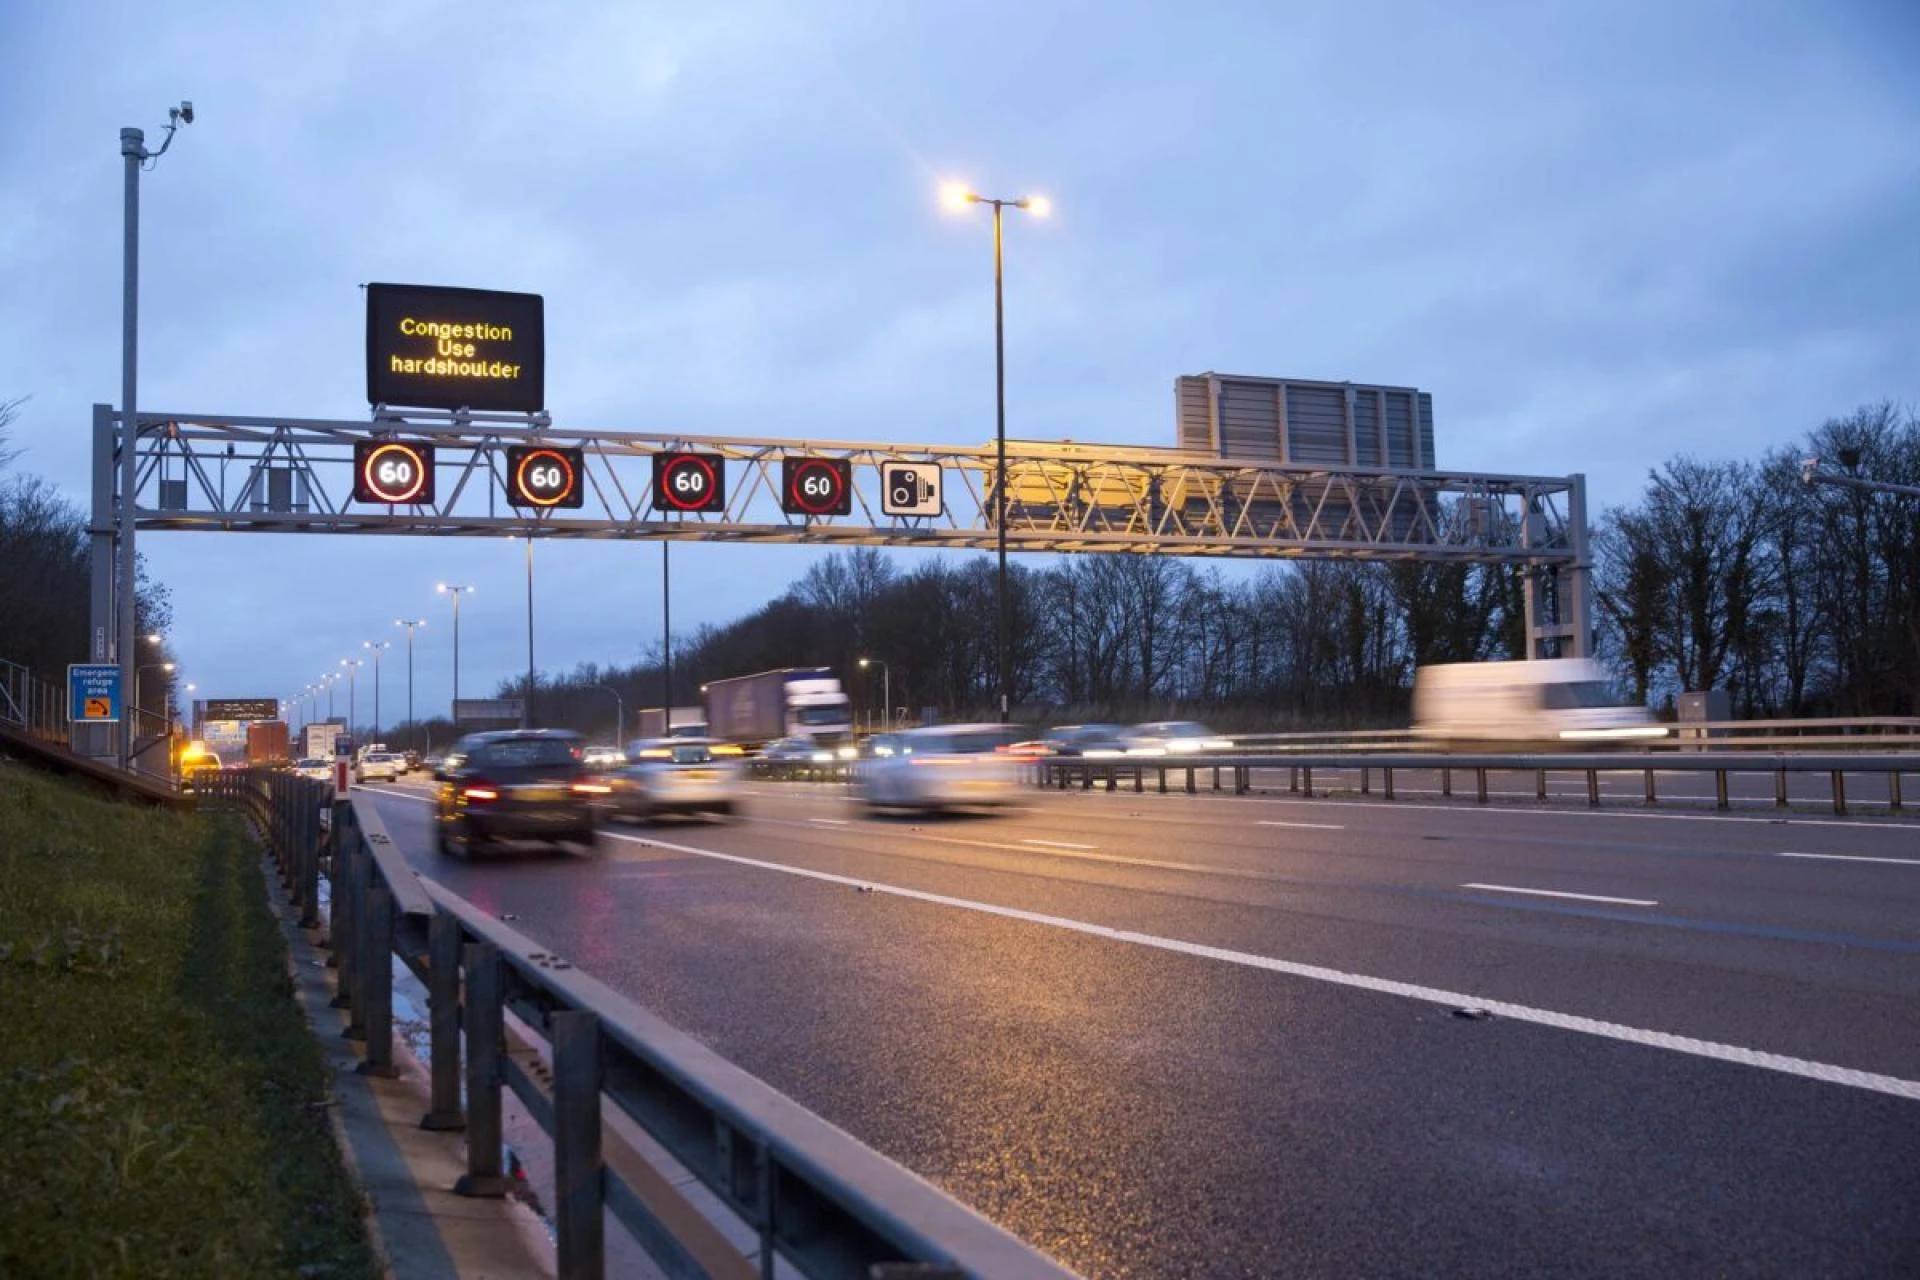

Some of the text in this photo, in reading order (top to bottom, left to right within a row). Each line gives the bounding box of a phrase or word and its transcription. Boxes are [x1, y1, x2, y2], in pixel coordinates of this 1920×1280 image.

[400, 318, 512, 341] Congestion
[438, 339, 475, 357] Use
[391, 355, 521, 378] hardshoulder
[379, 461, 411, 483] 60
[531, 466, 560, 487] 60
[676, 472, 703, 492] 60
[804, 477, 830, 496] 60
[73, 668, 120, 678] Emergenc
